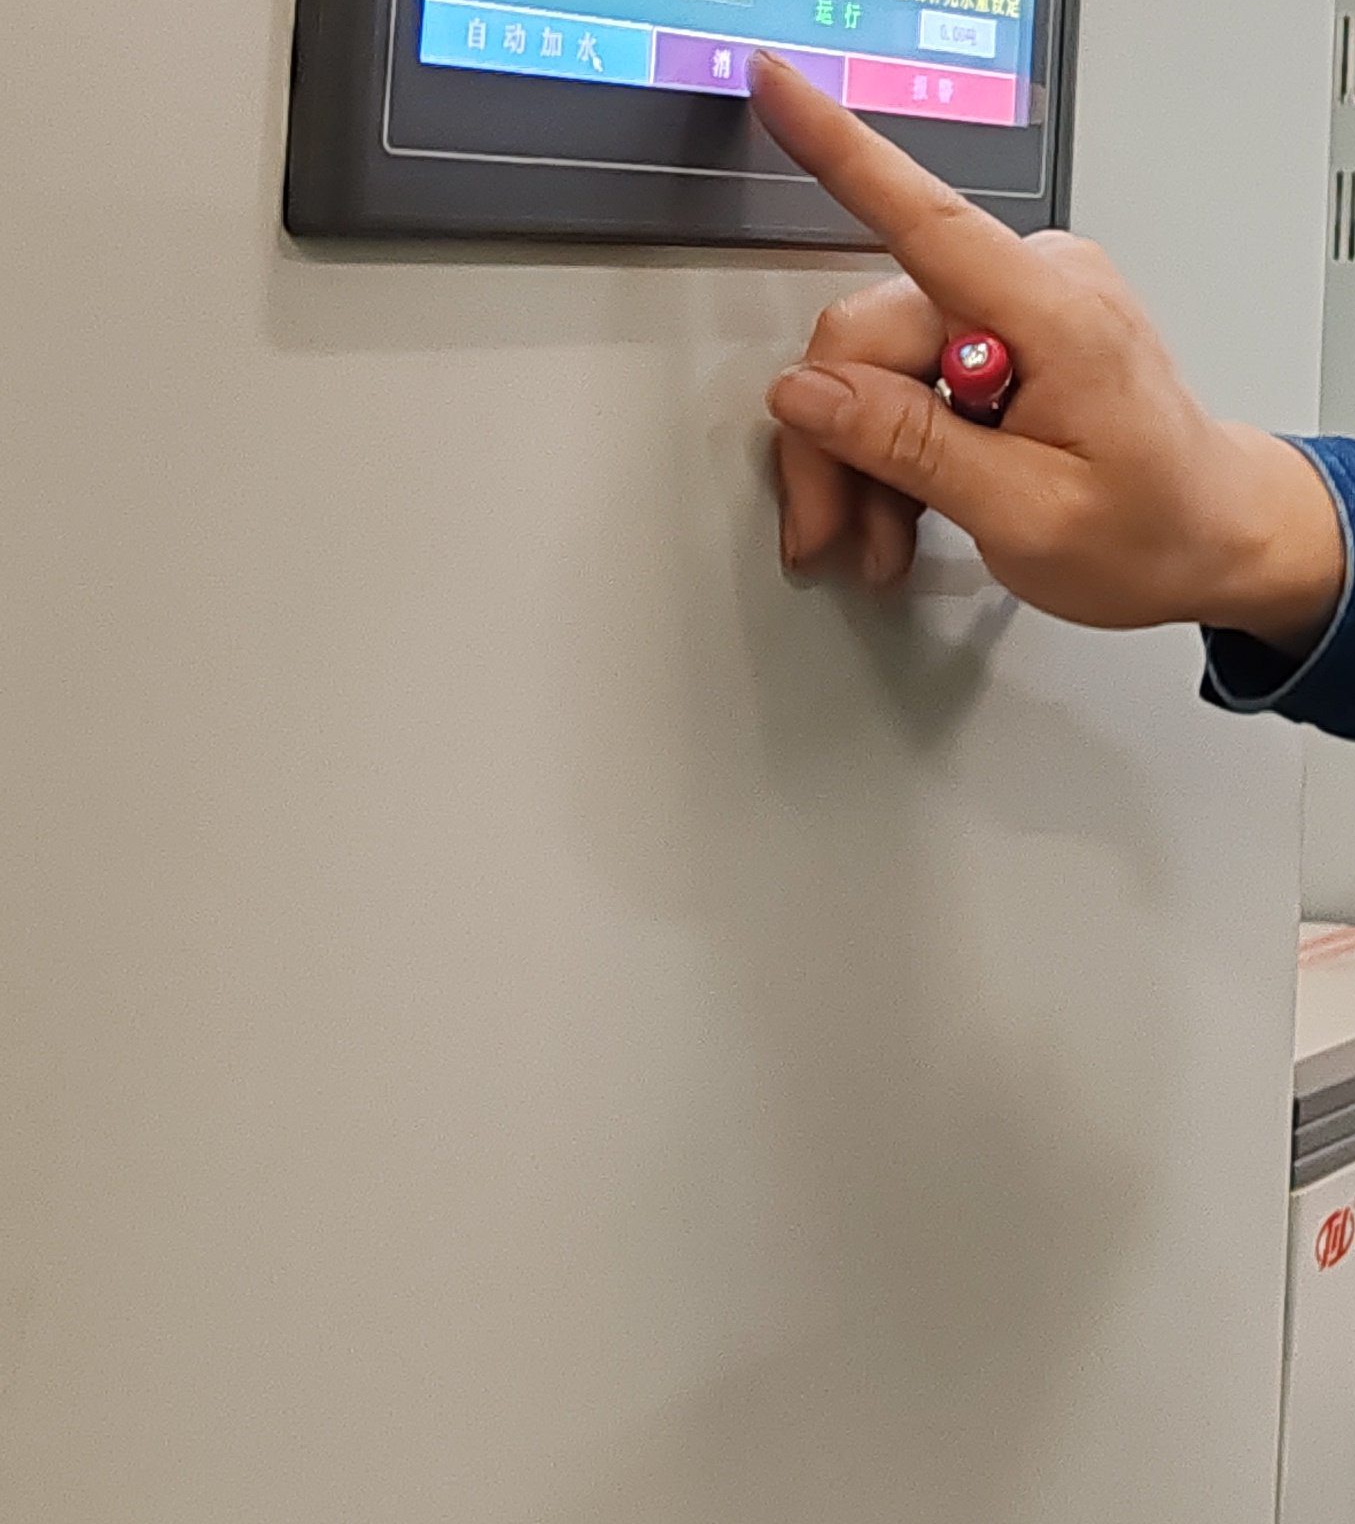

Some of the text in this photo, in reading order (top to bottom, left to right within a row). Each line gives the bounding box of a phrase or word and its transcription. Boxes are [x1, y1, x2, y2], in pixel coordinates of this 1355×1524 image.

[815, 0, 862, 28] 运行
[467, 17, 600, 63] 自动加水
